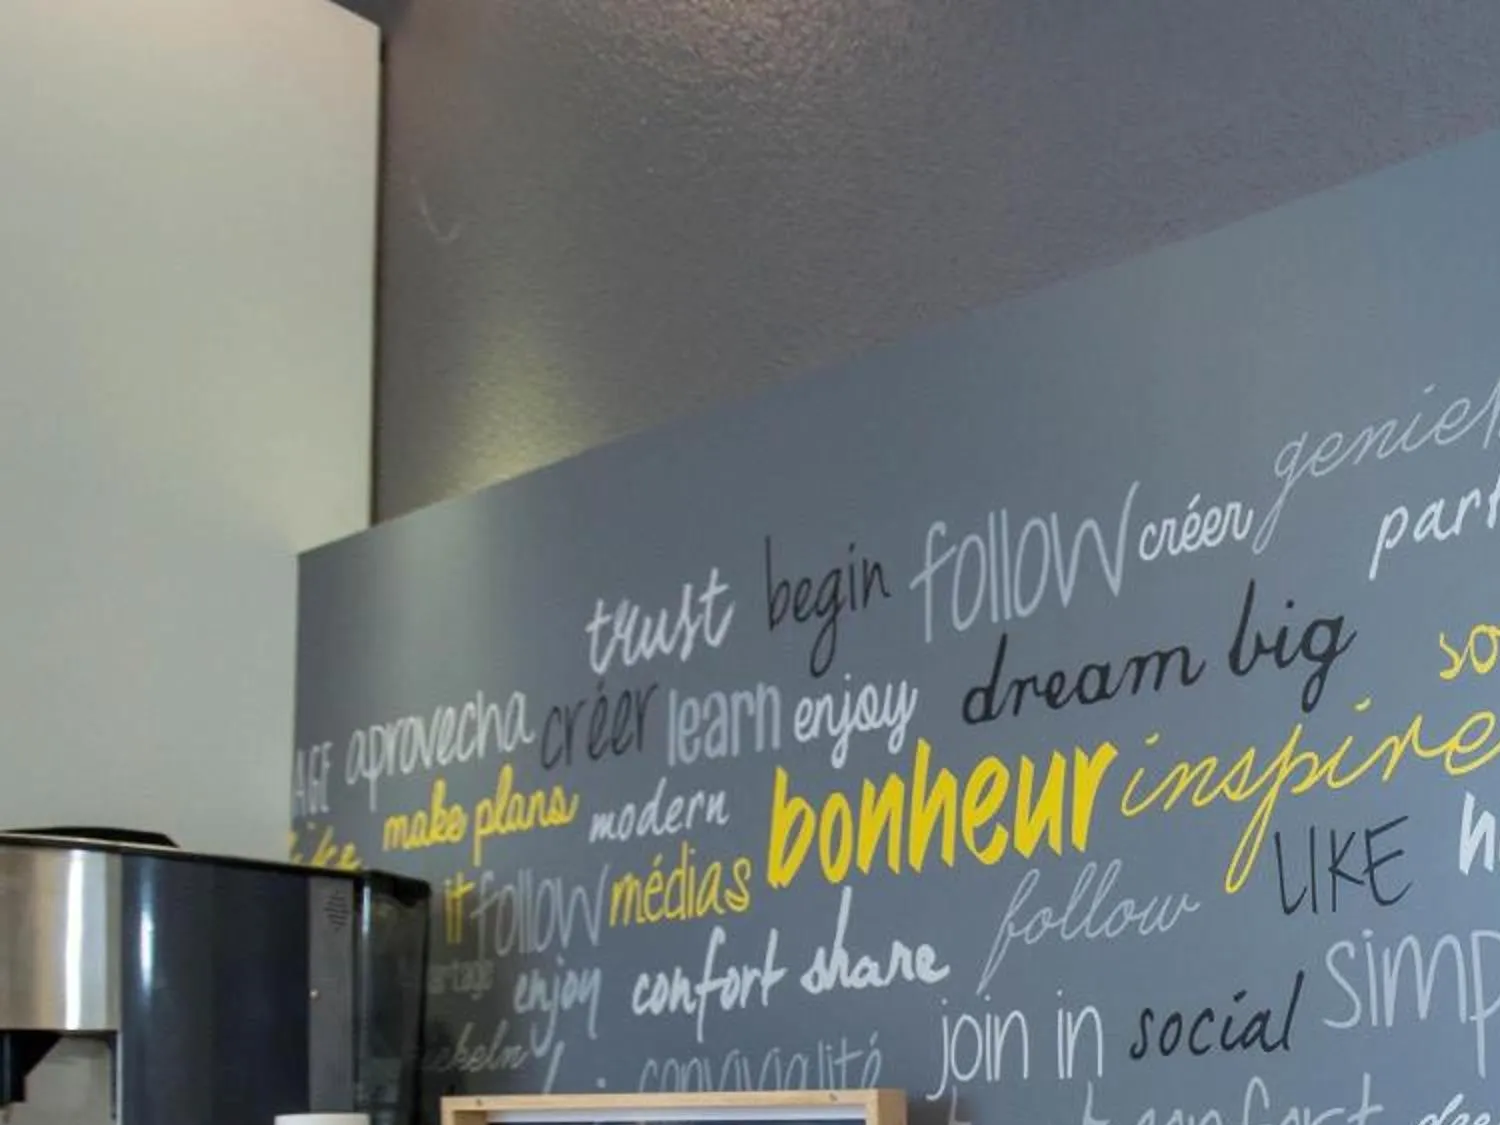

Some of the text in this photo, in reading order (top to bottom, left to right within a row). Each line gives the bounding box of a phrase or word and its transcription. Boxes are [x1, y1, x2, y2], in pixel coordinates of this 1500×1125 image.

[765, 535, 891, 678] begin
[909, 480, 1254, 643] follow créer
[585, 567, 735, 674] trust
[961, 578, 1358, 726] dream big
[344, 690, 535, 813] aprovecha
[540, 680, 660, 772] créer
[666, 682, 782, 767] learn
[793, 673, 918, 769] enjoy
[382, 763, 580, 868] make plans
[588, 777, 730, 844] modern
[766, 736, 1120, 890] bonheur
[469, 863, 609, 960] follow
[608, 841, 753, 927] médias
[1273, 814, 1415, 915] LIKE
[800, 884, 951, 997] share
[976, 858, 1201, 996] follow
[512, 953, 602, 1059] enjoy
[632, 926, 788, 1043] confort
[1128, 970, 1304, 1060] social
[925, 990, 1103, 1100] join in
